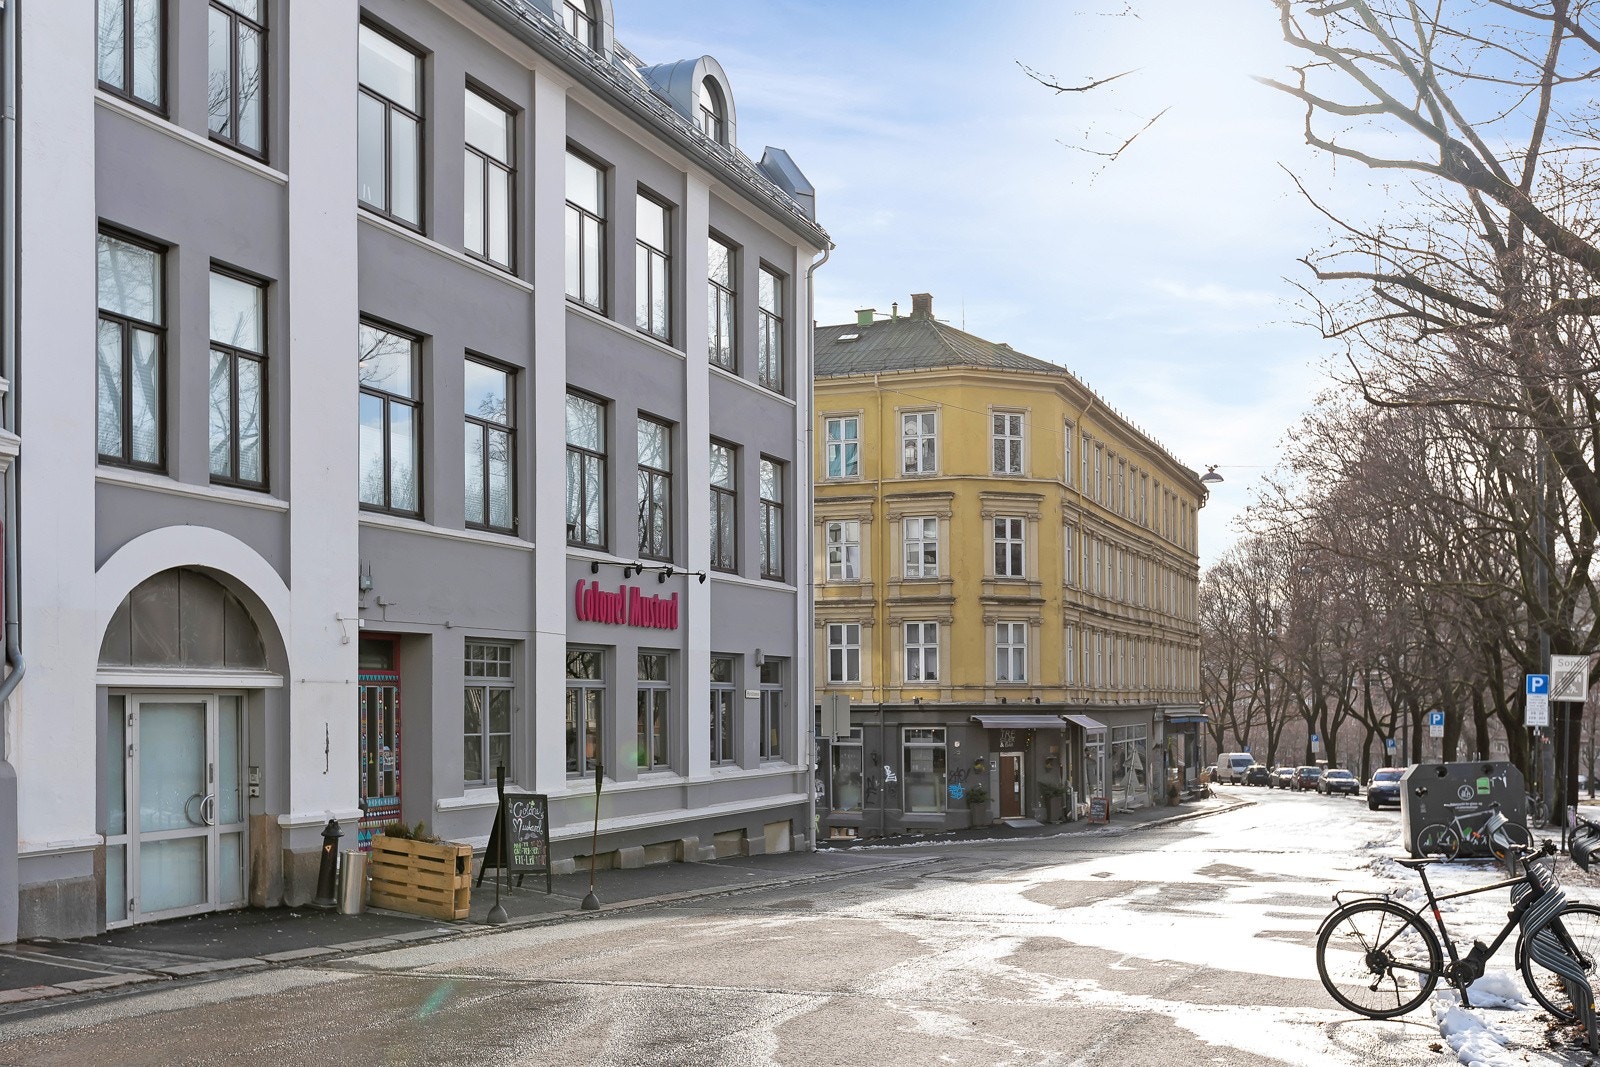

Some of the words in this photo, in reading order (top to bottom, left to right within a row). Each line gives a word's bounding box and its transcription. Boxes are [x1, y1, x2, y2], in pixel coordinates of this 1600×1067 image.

[575, 579, 626, 625] Colonel
[628, 586, 678, 630] Mustard
[1558, 659, 1581, 667] Son
[1532, 677, 1543, 692] P
[1433, 714, 1441, 724] P
